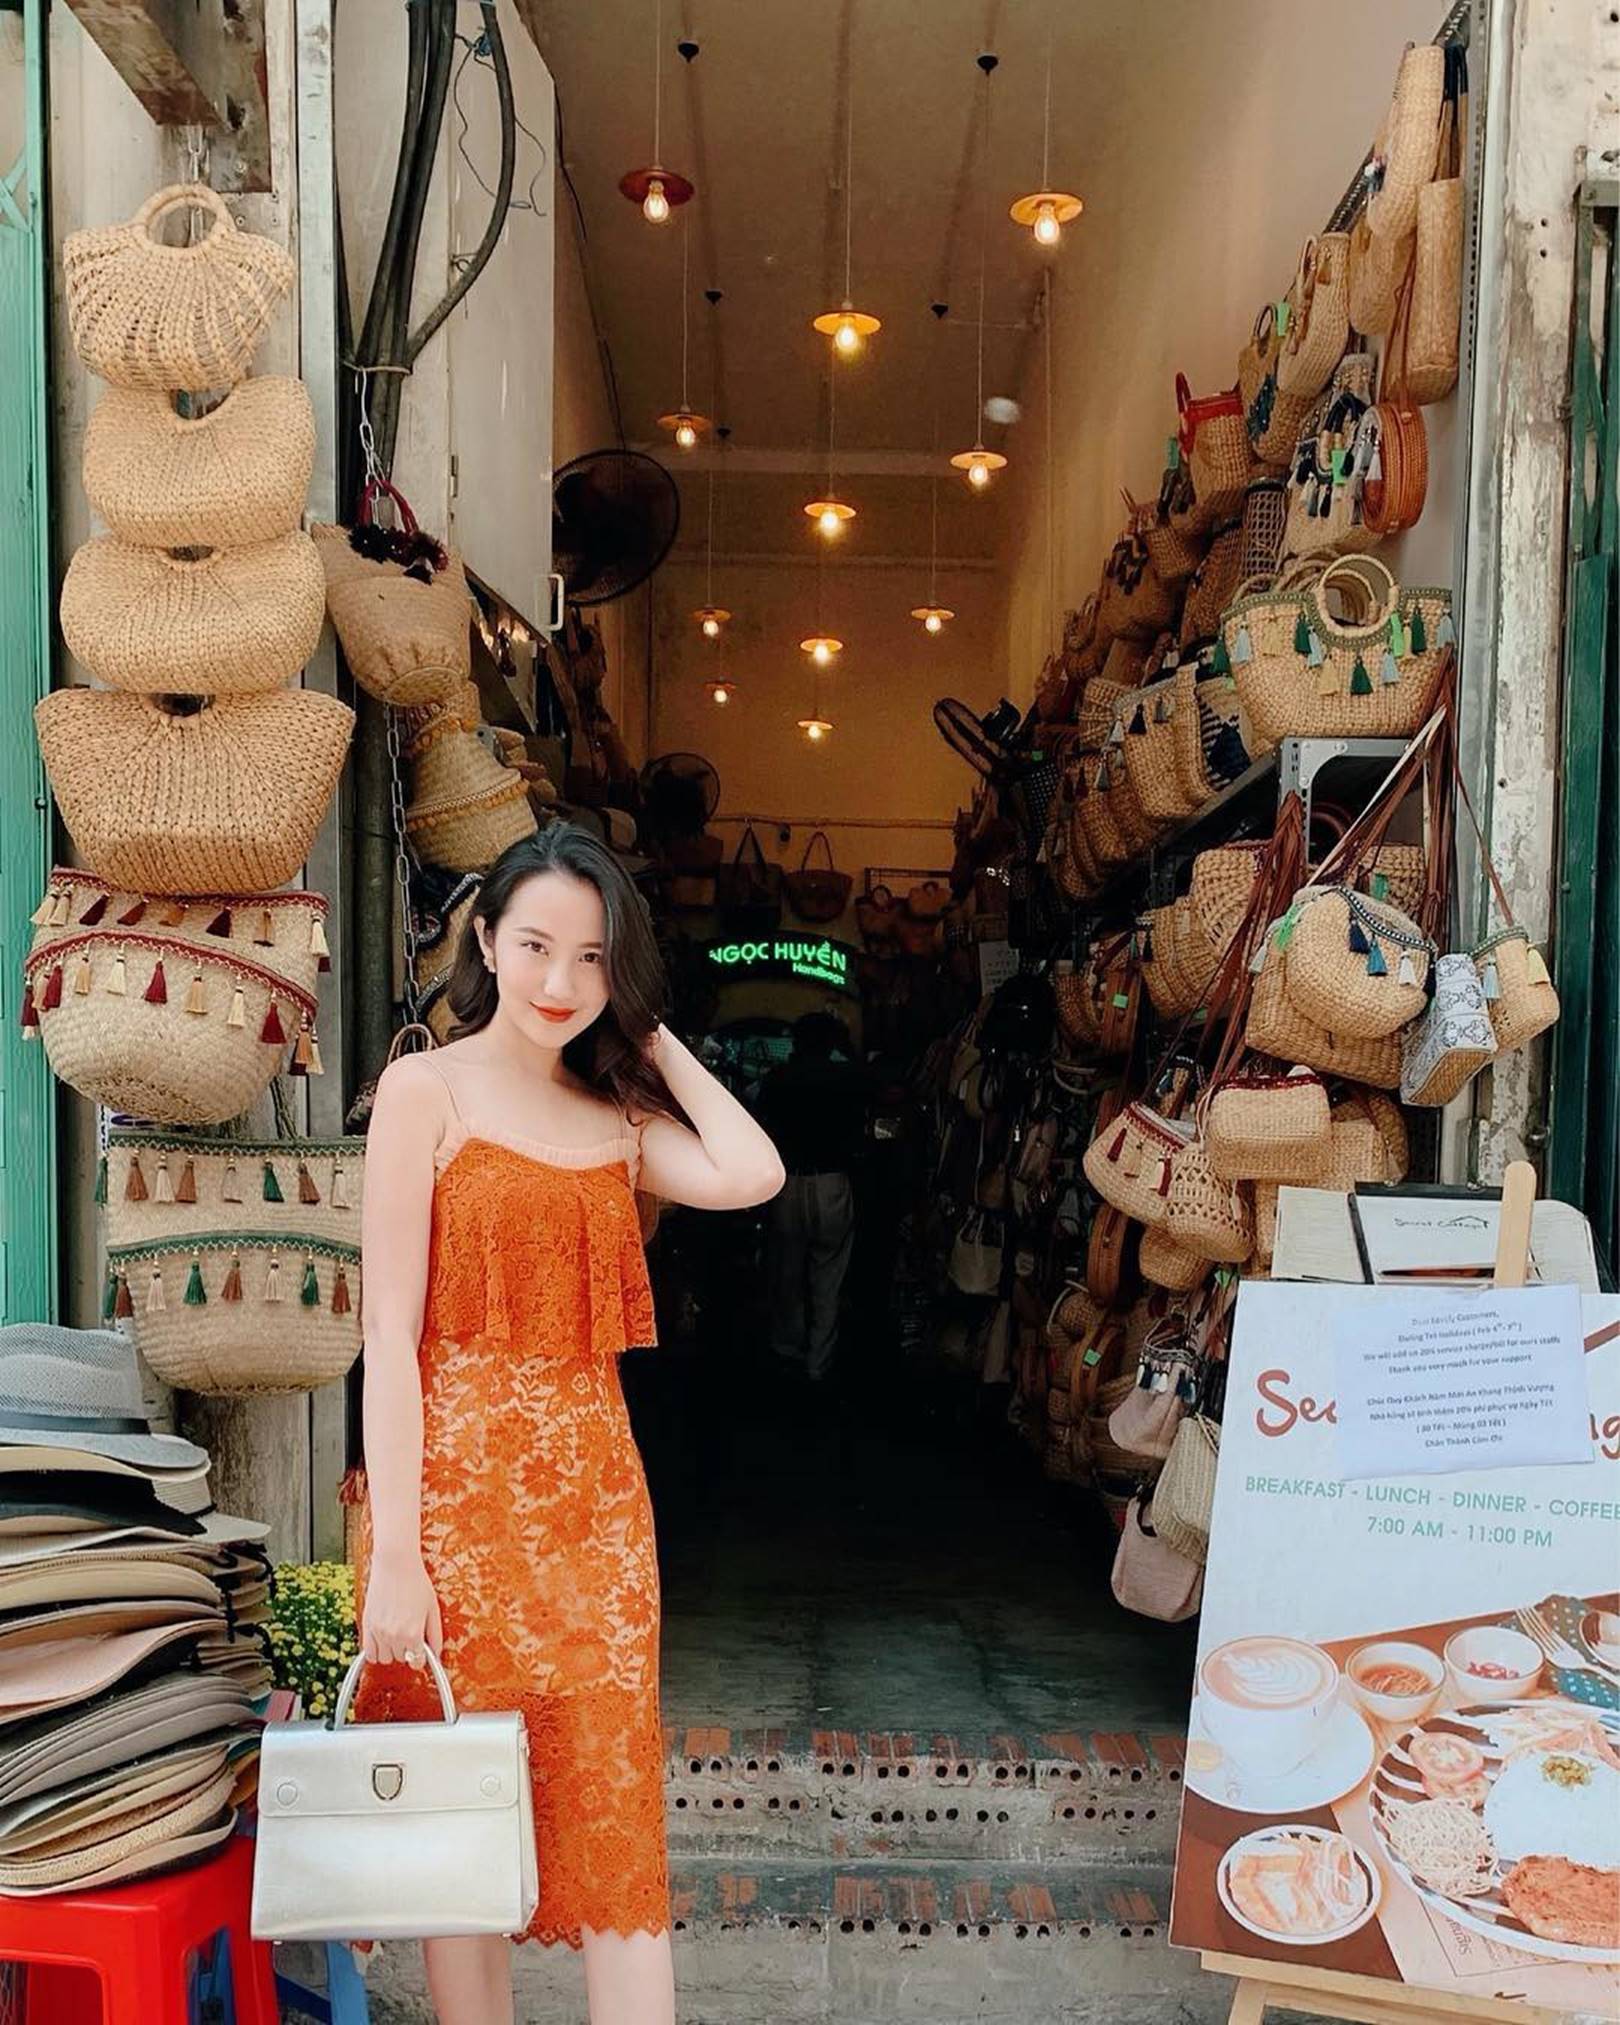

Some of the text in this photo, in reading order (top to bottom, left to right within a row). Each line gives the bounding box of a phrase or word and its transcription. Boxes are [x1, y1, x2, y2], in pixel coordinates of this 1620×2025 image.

[1245, 1475, 1346, 1499] BREAKFAST
[1366, 1484, 1431, 1505] LUNCH
[1452, 1490, 1527, 1513] DINNER
[1367, 1515, 1405, 1535] 7:00
[1412, 1519, 1444, 1539] AM
[1467, 1524, 1516, 1545] 11:00
[1523, 1528, 1552, 1548] PM
